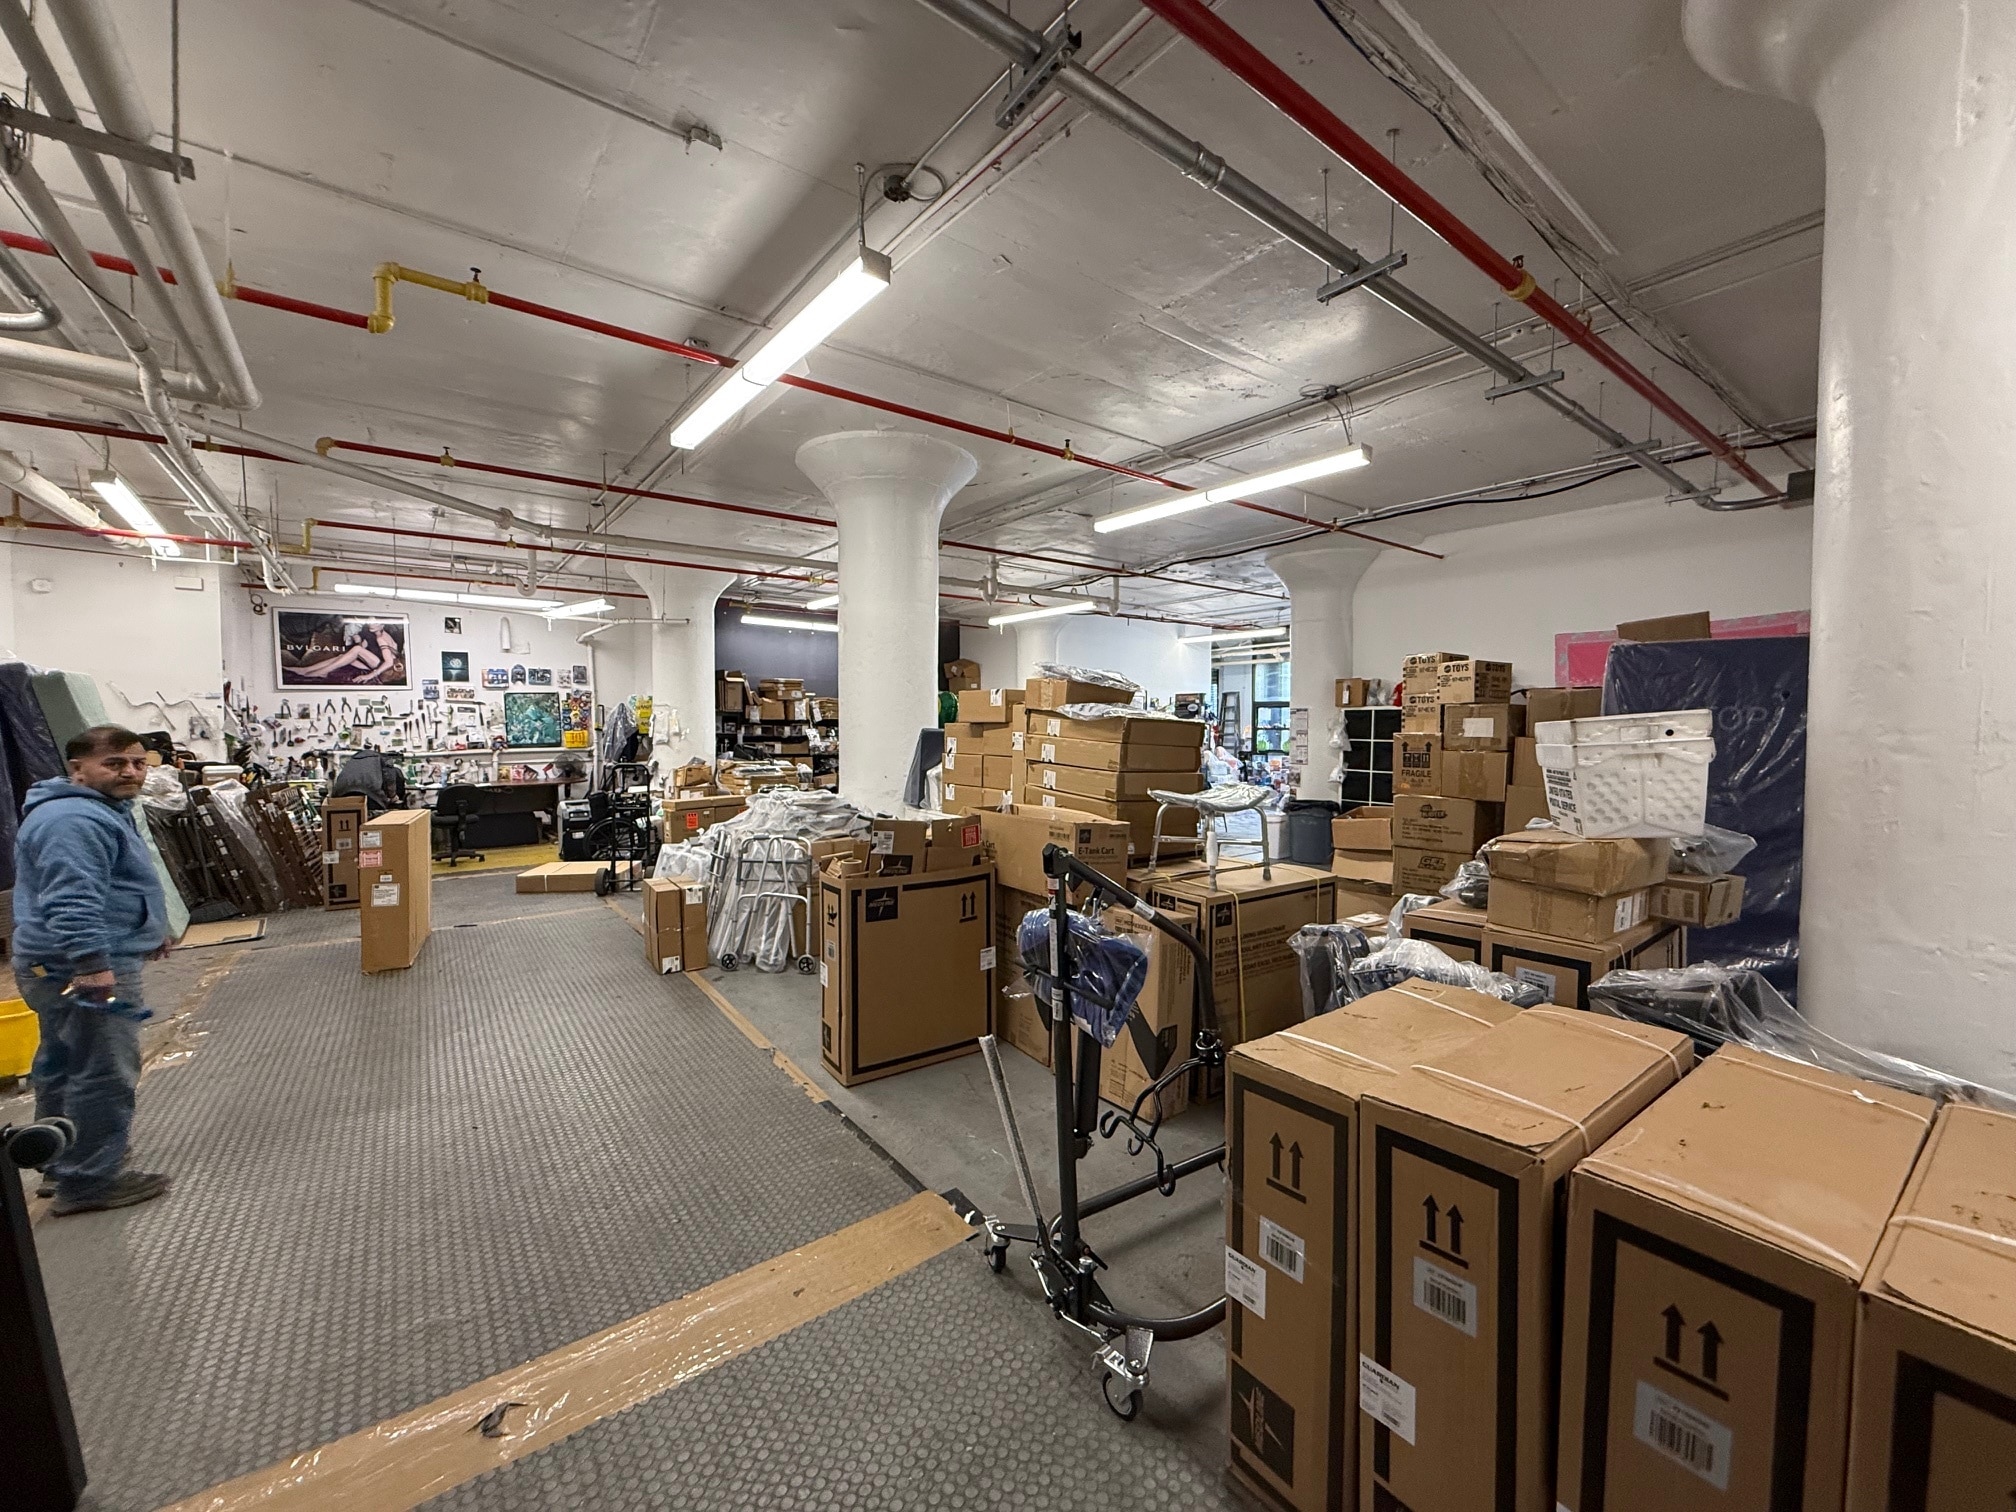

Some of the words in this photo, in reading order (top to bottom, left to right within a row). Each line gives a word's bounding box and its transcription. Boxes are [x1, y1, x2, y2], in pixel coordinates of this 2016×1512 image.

[286, 644, 346, 652] BVLGARI
[1418, 656, 1436, 664] TOYS
[1452, 664, 1469, 672] TOYS
[1417, 696, 1435, 704] TOYS
[1401, 769, 1432, 778] FRAGILE
[1079, 847, 1100, 855] E-Tank
[1101, 847, 1115, 855] Cart
[1361, 1360, 1400, 1390] GUARDIAN
